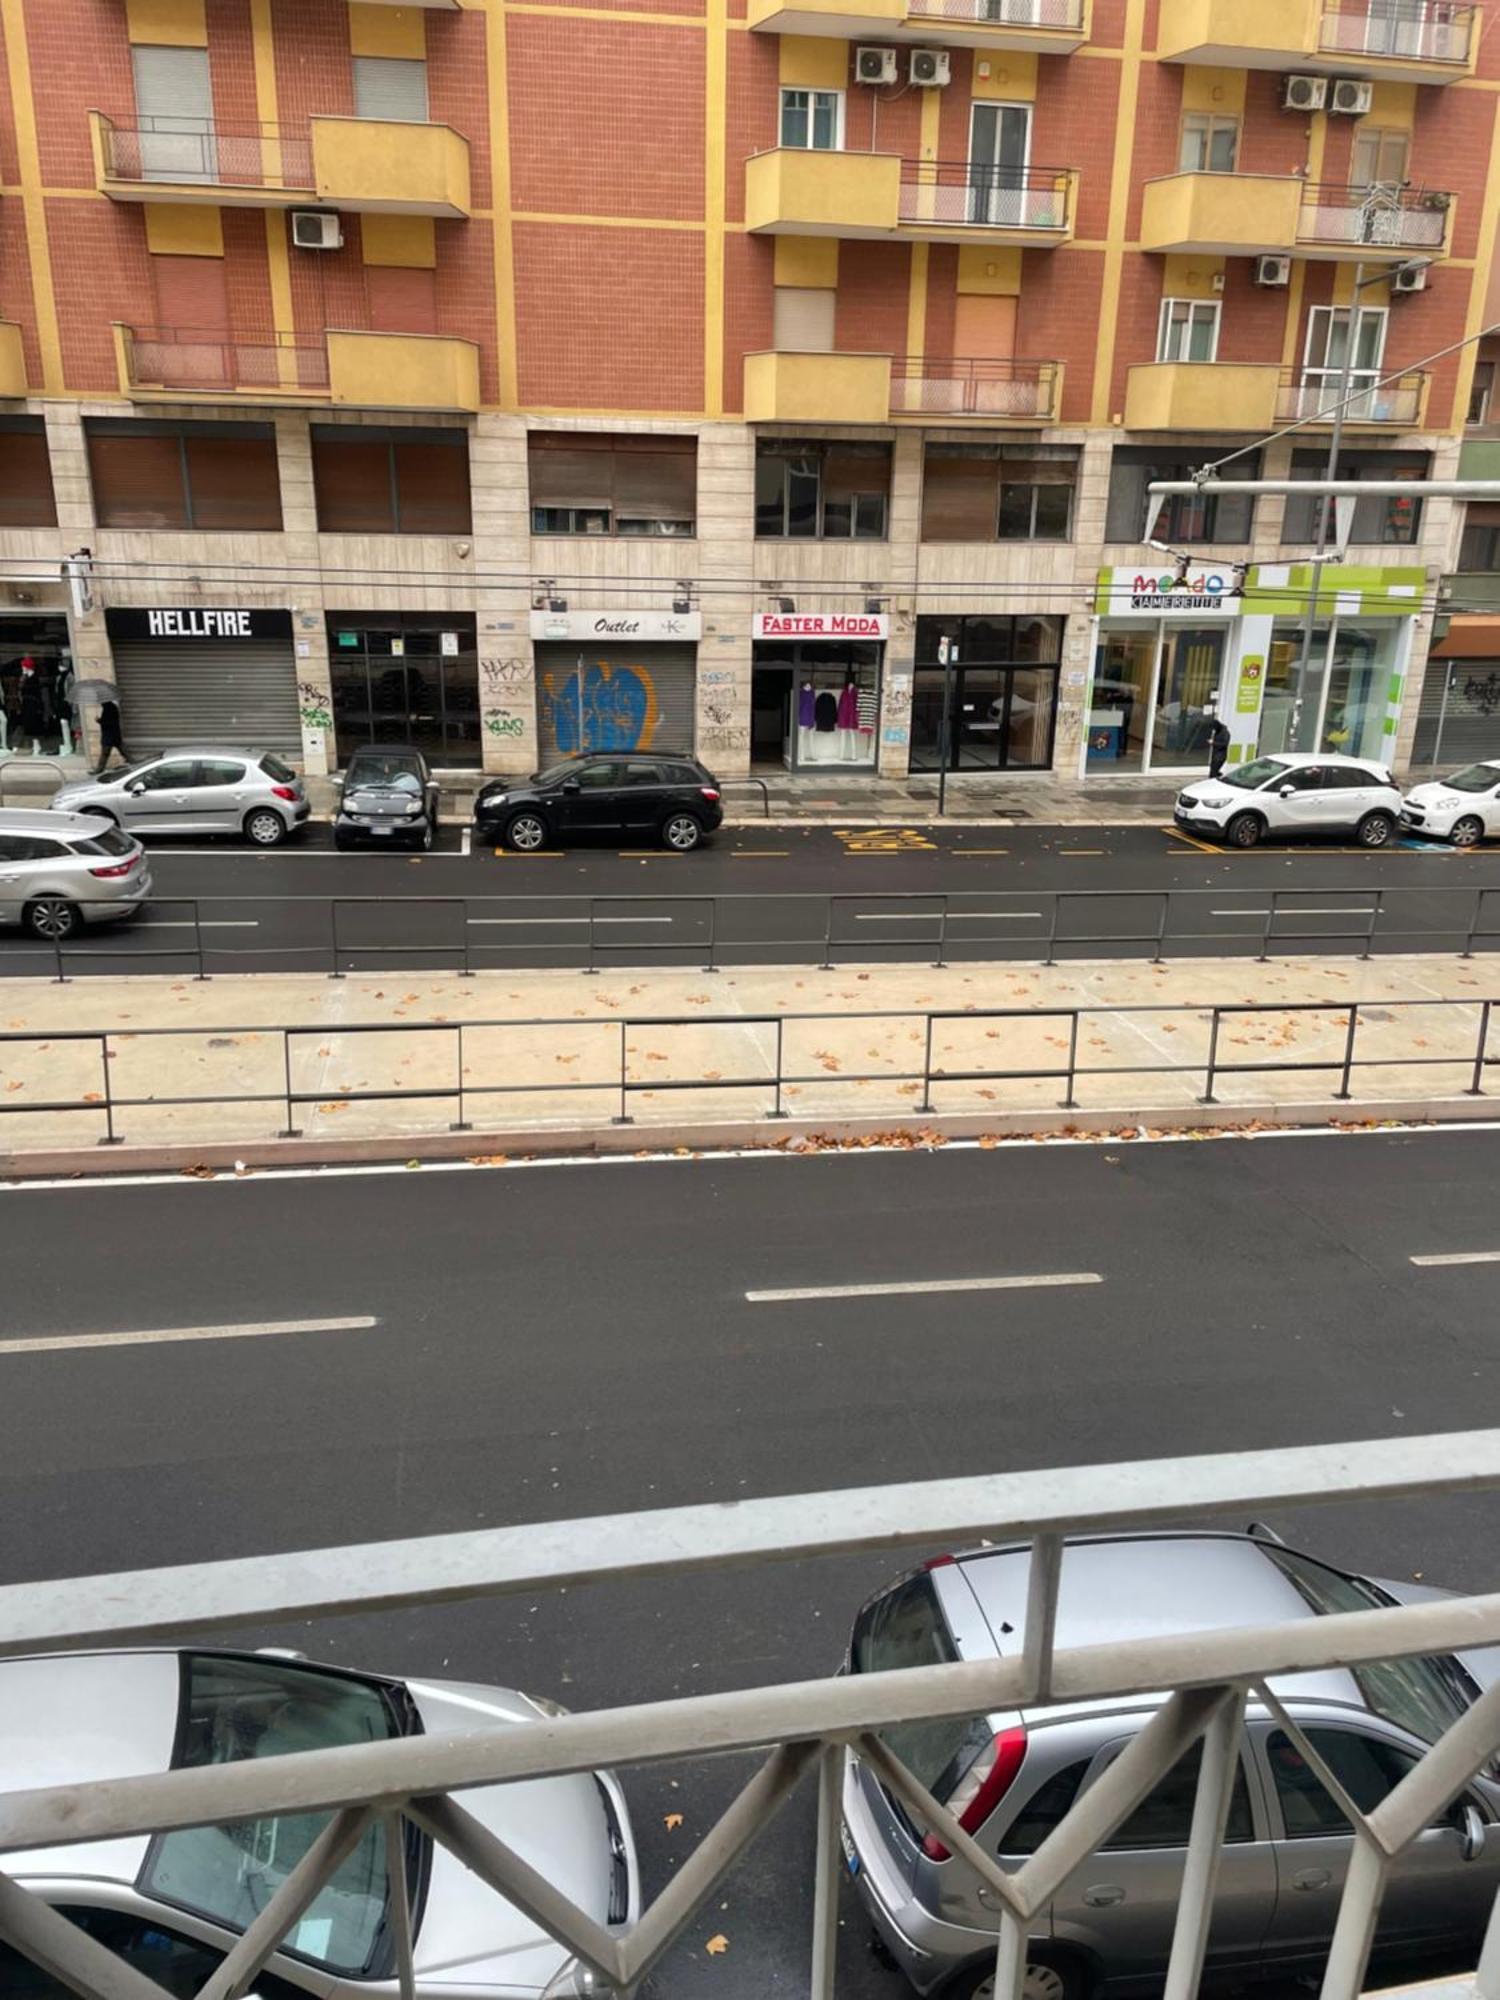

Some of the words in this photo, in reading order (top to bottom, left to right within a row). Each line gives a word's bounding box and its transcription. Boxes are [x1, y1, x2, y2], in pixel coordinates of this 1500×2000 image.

[1131, 595, 1222, 609] CAMERETTE
[148, 610, 252, 636] HELLFIRE
[594, 618, 640, 633] Outlet
[762, 615, 824, 631] FASTER
[831, 616, 881, 632] MODA
